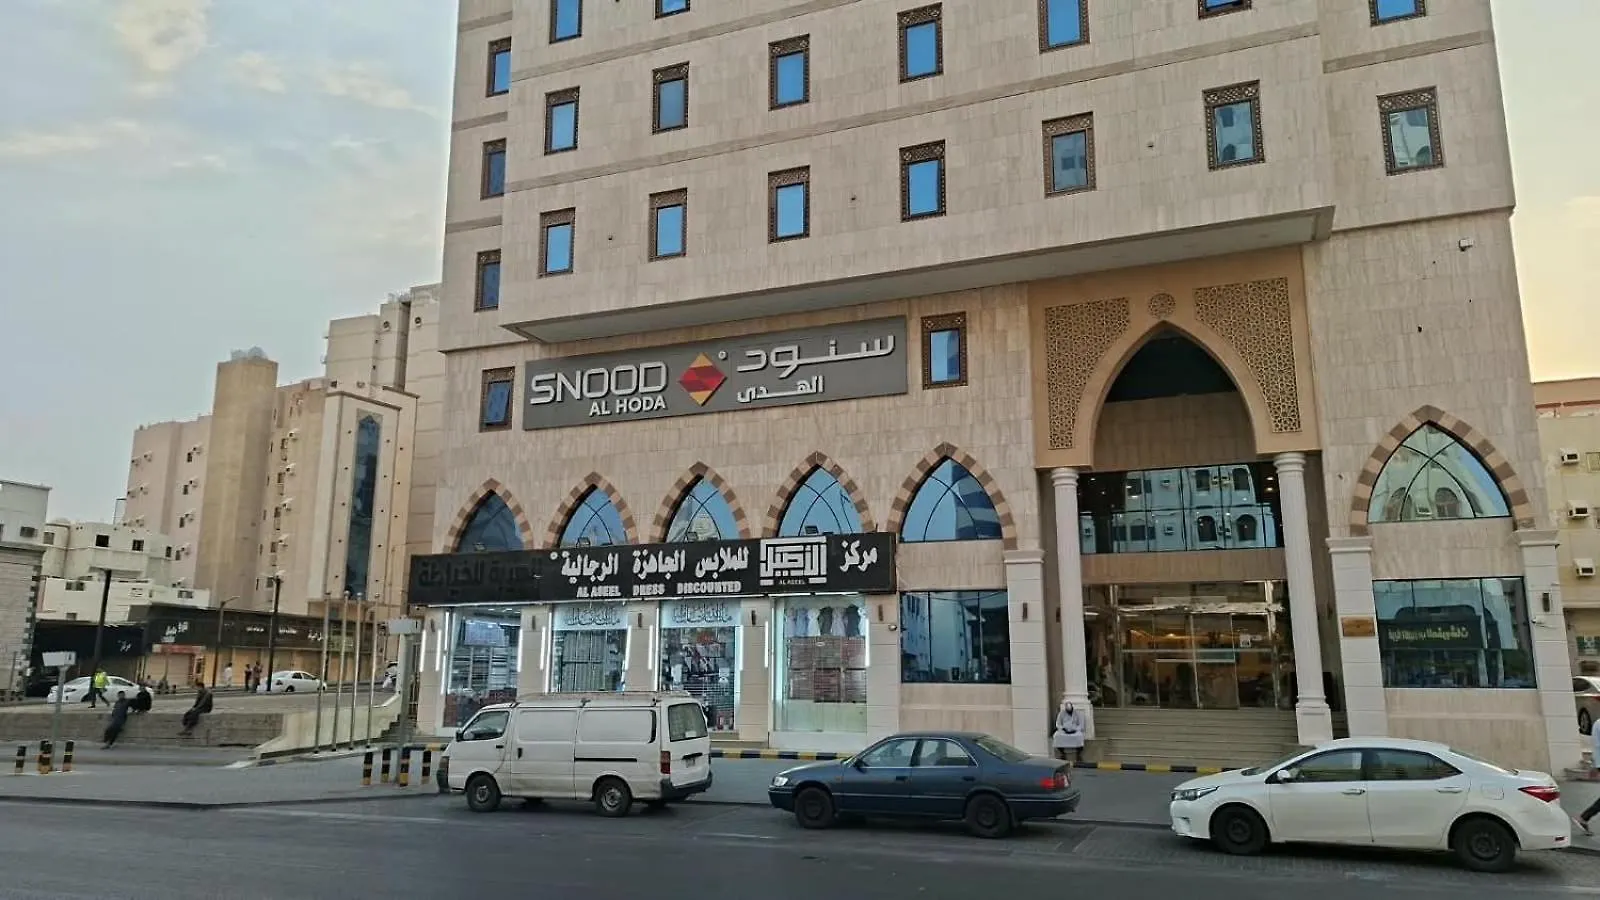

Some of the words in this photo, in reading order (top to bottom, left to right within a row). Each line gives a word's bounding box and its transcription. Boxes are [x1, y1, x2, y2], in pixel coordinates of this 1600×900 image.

[737, 335, 894, 379] سنود
[530, 361, 667, 404] SNOOD
[737, 375, 824, 403] الهدى
[589, 401, 611, 416] AL
[615, 395, 666, 413] HODA
[561, 551, 619, 584] الرجالية
[632, 549, 685, 580] الجاهزة
[695, 546, 749, 579] للملابس
[840, 540, 877, 572] مركز
[576, 586, 590, 598] AL
[677, 581, 742, 595] DISCOUNTED
